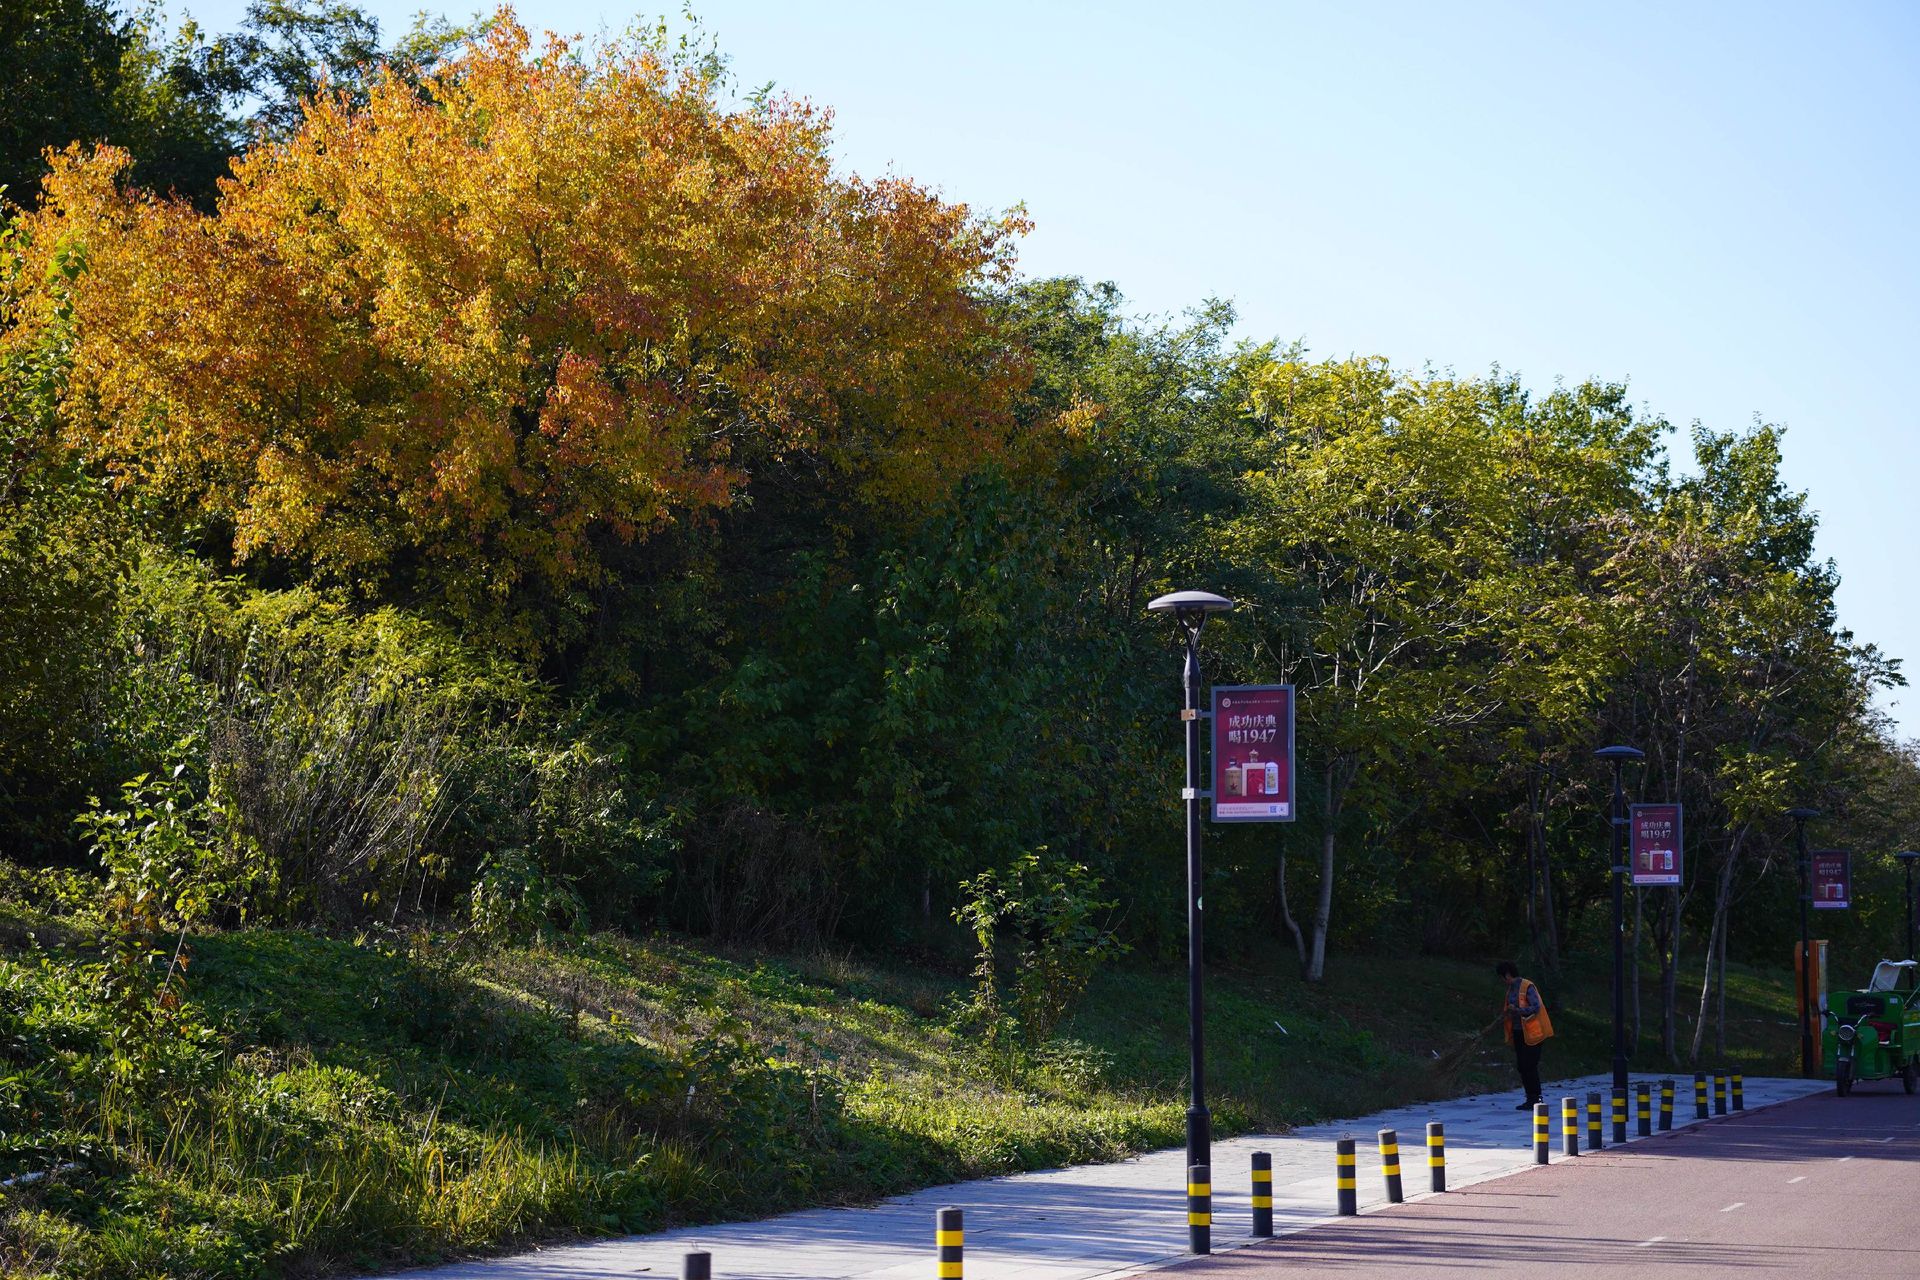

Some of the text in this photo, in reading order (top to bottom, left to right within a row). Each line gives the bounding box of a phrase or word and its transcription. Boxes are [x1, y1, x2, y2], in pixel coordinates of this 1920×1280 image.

[1228, 714, 1277, 728] 成功庆典
[1228, 729, 1277, 744] 喝1947
